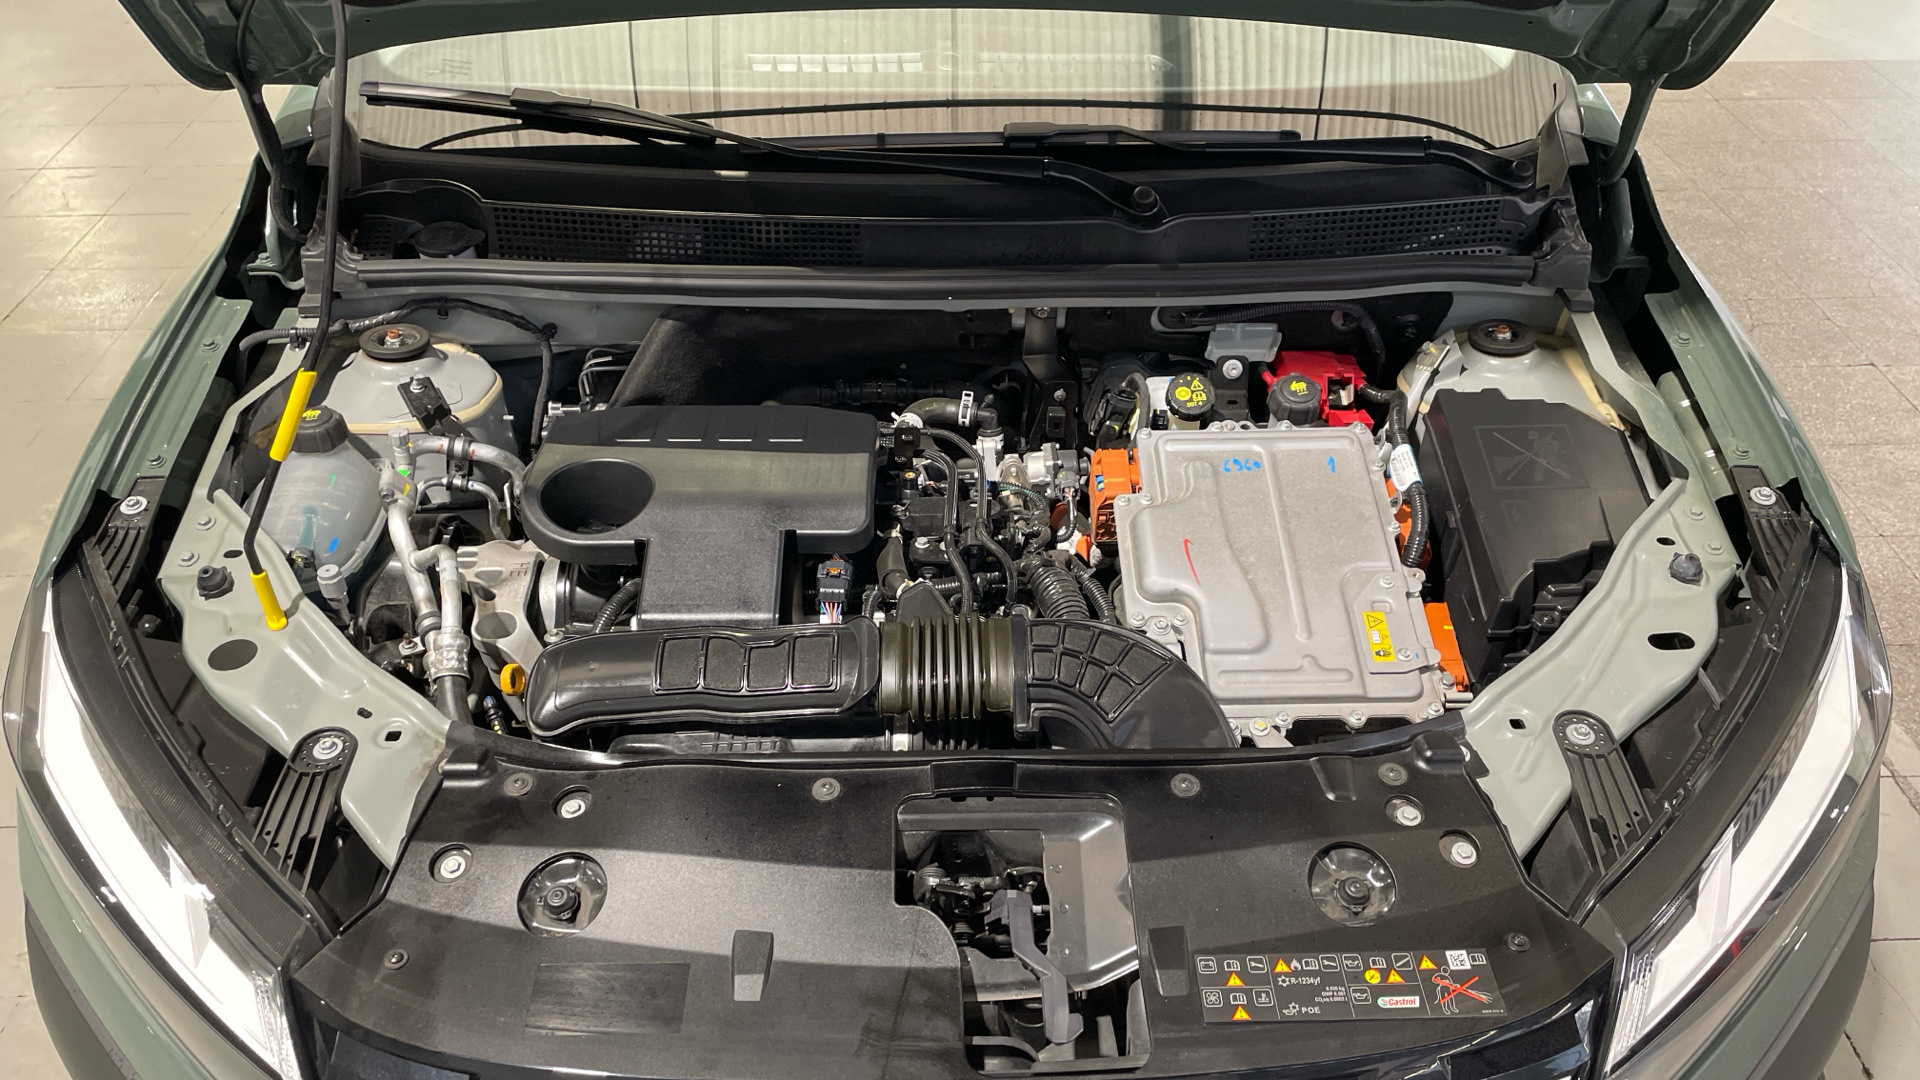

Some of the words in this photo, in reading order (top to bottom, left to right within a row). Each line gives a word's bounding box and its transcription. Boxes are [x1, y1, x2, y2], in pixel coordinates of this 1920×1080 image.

[1290, 976, 1320, 985] R-1234yf
[1388, 998, 1416, 1006] Castrol
[1301, 1006, 1321, 1014] POE
